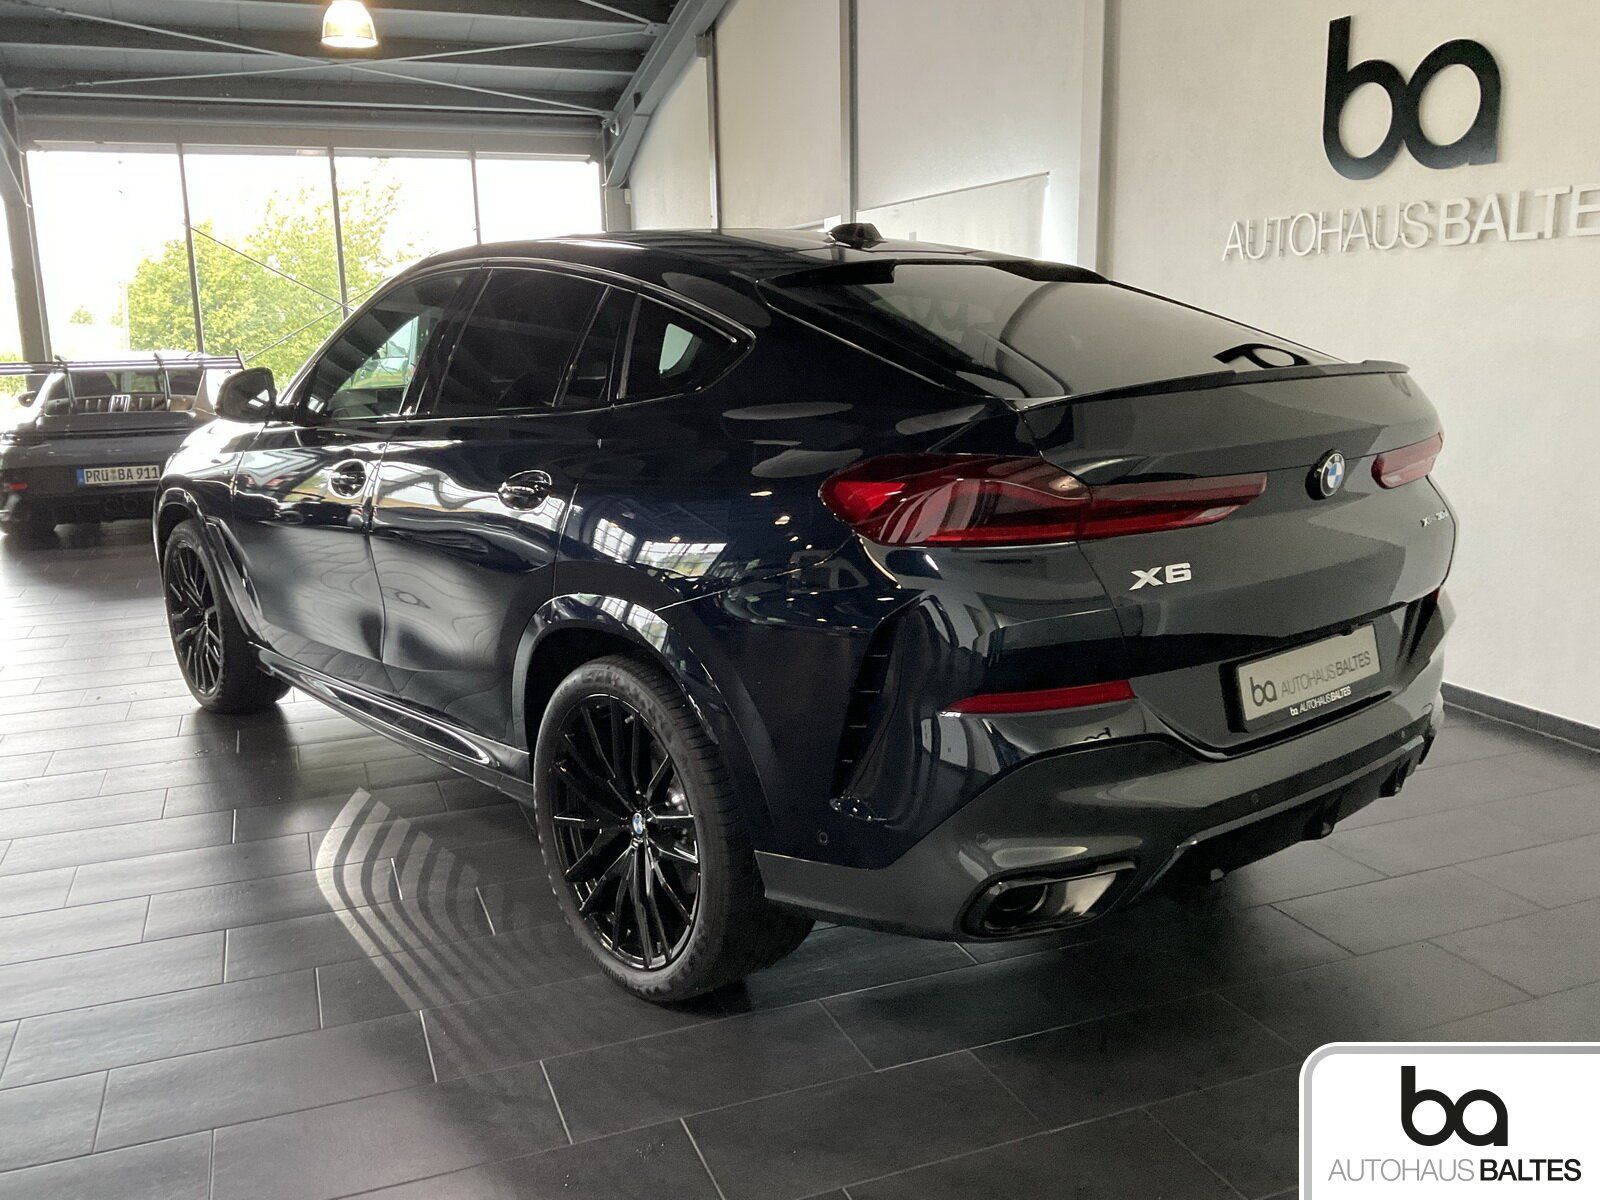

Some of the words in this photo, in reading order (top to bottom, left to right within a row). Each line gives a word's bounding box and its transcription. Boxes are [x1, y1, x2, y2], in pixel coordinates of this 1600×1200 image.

[1322, 15, 1501, 180] ba
[1222, 200, 1432, 261] AUTOHAUS
[86, 470, 109, 482] PRÜ
[117, 468, 133, 480] BA
[136, 467, 159, 479] 911
[1128, 562, 1192, 591] X6
[1249, 676, 1278, 707] ba
[1281, 664, 1336, 696] AUTOHAUS
[1336, 651, 1371, 677] BALTES
